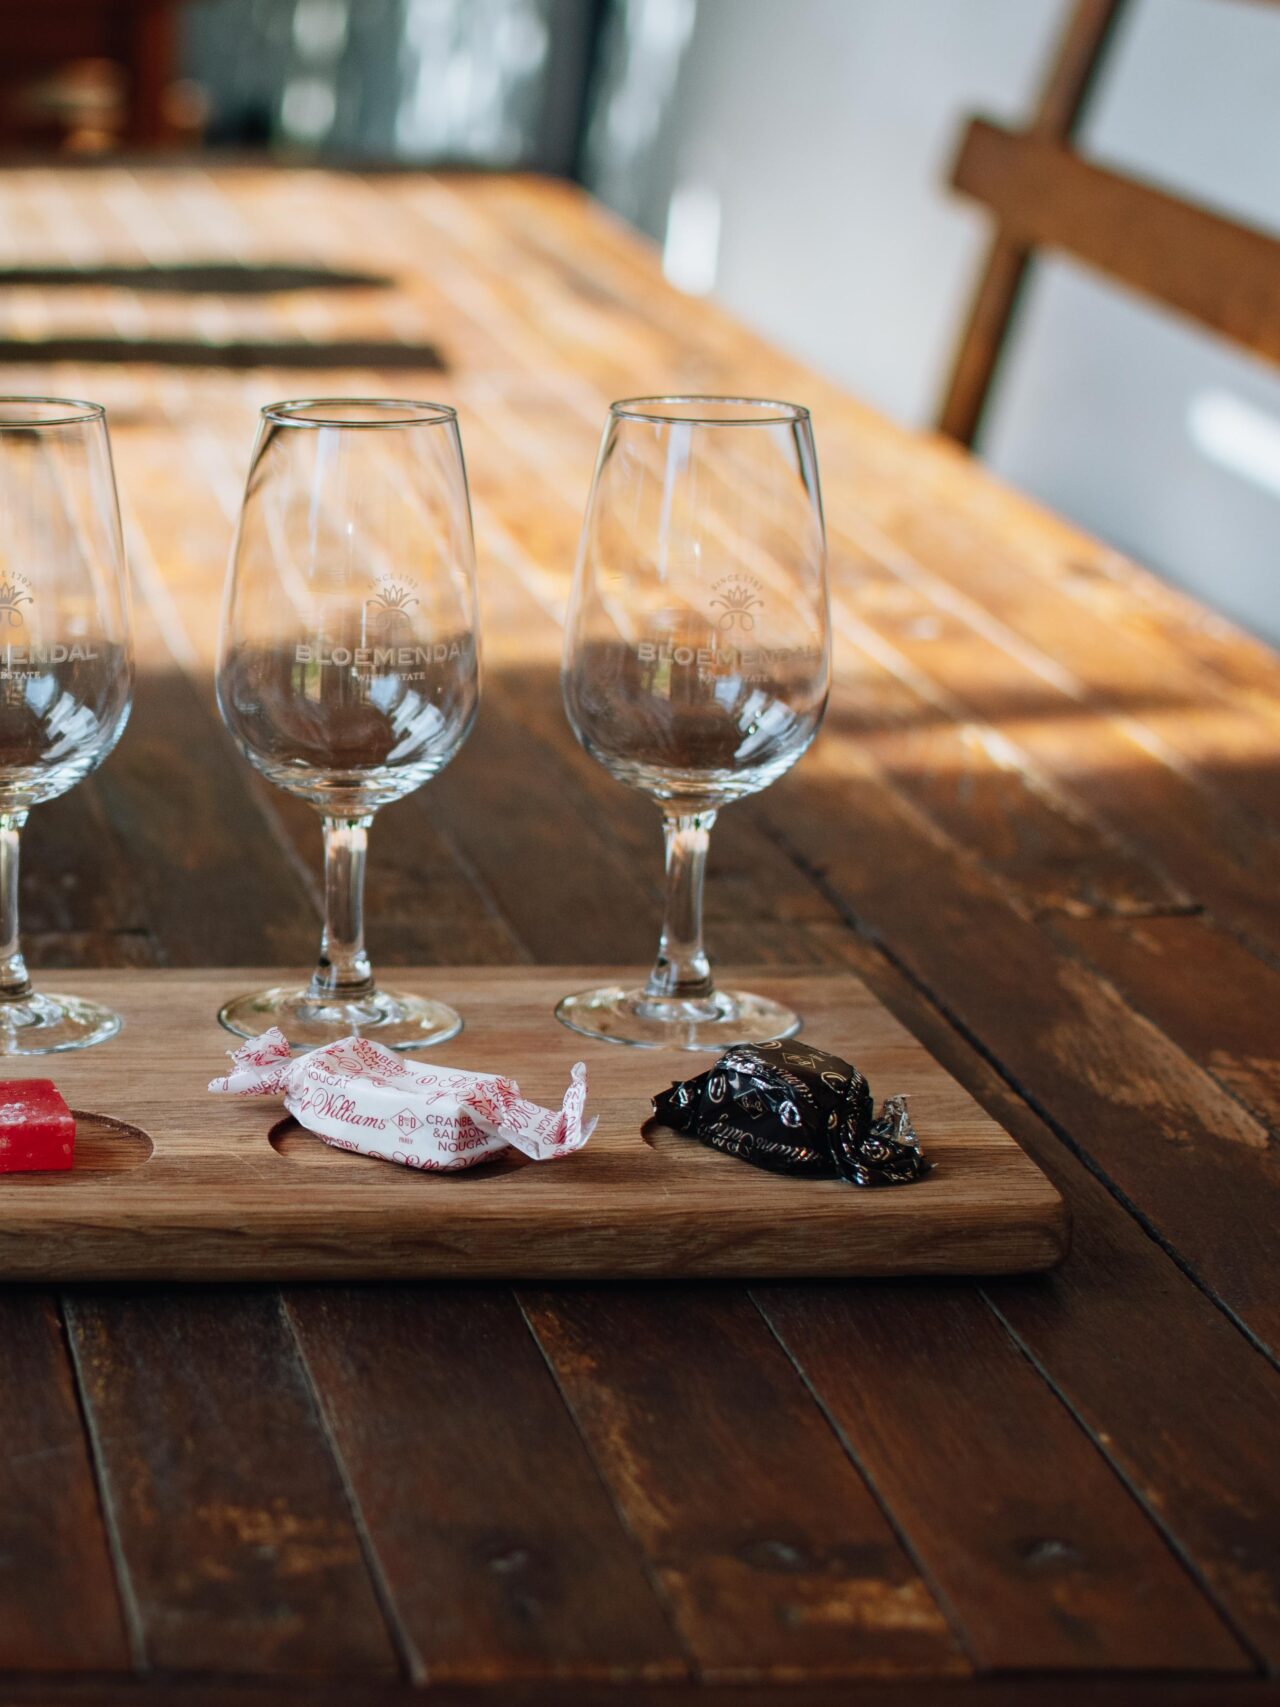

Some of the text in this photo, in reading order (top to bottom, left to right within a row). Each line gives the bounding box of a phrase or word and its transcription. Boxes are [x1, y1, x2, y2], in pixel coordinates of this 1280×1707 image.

[296, 640, 471, 667] BLOEMENDAL
[310, 1087, 387, 1131] Williams
[425, 1114, 475, 1129] CRANBE
[433, 1126, 485, 1141] &ALMON
[438, 1136, 490, 1153] NOUGAT
